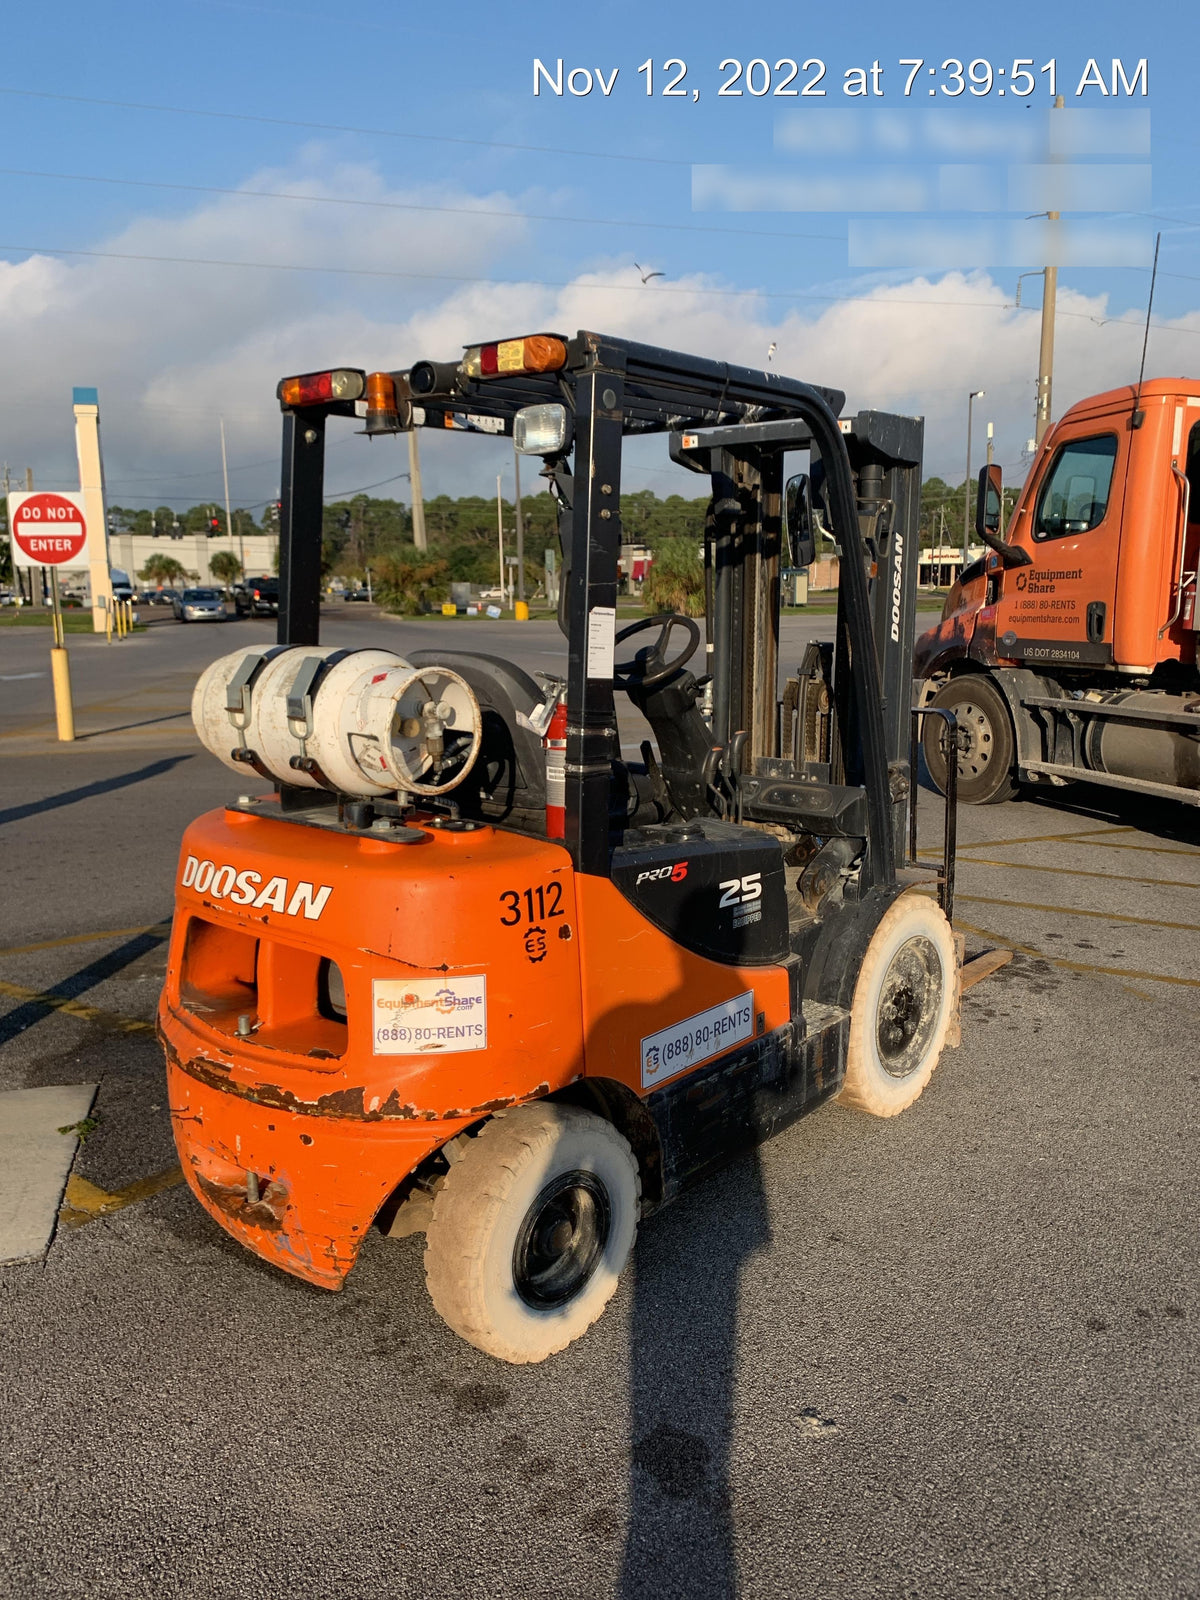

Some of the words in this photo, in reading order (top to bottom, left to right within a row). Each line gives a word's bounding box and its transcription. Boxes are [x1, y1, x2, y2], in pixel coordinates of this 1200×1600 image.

[22, 507, 41, 519] DO
[47, 507, 74, 519] NOT
[30, 539, 72, 551] ENTER
[1029, 568, 1083, 582] Equipment
[891, 532, 903, 643] DOOSAN
[1027, 583, 1056, 593] Share
[1020, 600, 1037, 610] (888)
[1039, 600, 1076, 610] 80-RENTS
[1008, 613, 1080, 625] equipmentshare.com
[1023, 648, 1034, 656] US
[1035, 648, 1050, 657] DOT
[1051, 649, 1080, 660] 2834104
[636, 861, 689, 885] PRO5
[181, 855, 332, 920] DOOSAN
[719, 872, 762, 908] 25
[499, 881, 565, 926] 3112
[525, 935, 546, 953] ES
[376, 1028, 412, 1043] (888)
[414, 1024, 483, 1040] 80-RENTS
[646, 1051, 659, 1068] ES
[662, 1032, 693, 1066] (888)
[696, 1007, 750, 1047] 80-RENTS
